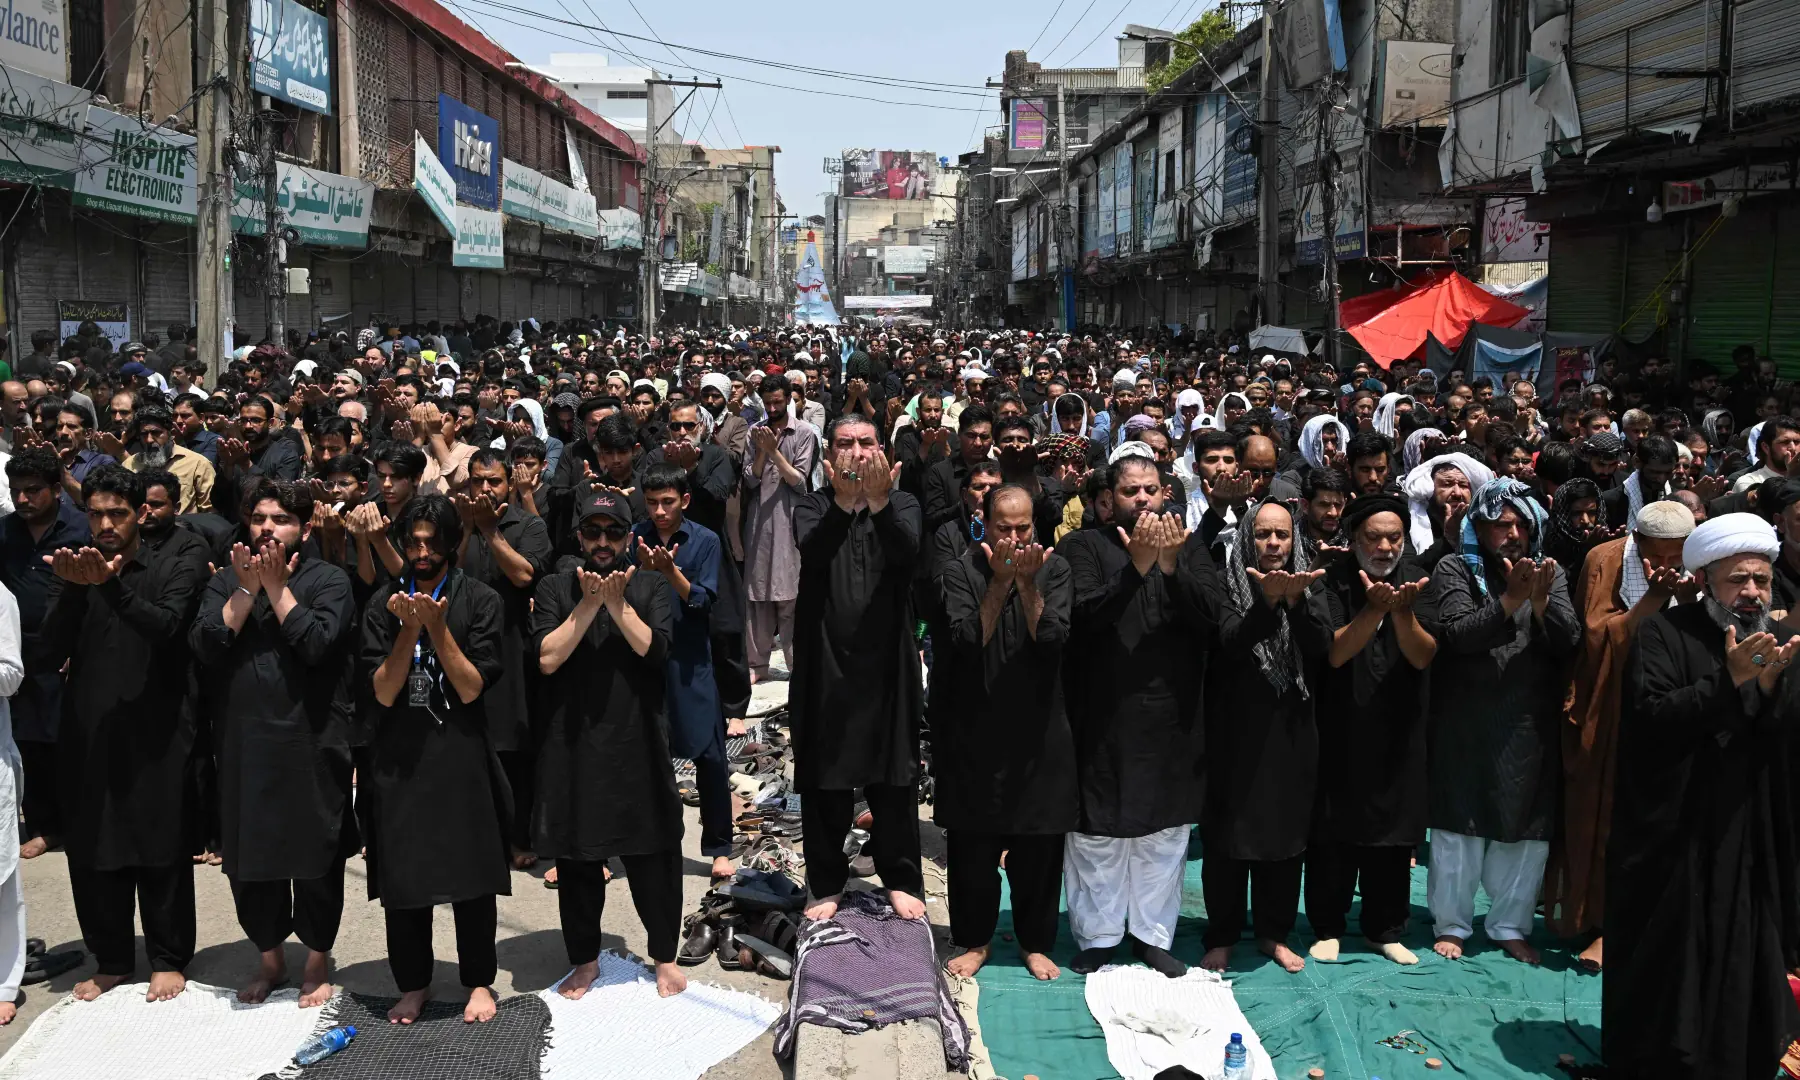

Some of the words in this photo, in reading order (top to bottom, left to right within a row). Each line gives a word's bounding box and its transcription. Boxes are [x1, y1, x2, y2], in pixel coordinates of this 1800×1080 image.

[110, 129, 187, 179] INSPIRE
[454, 119, 492, 177] Haier
[106, 168, 183, 205] ELECTRONICS
